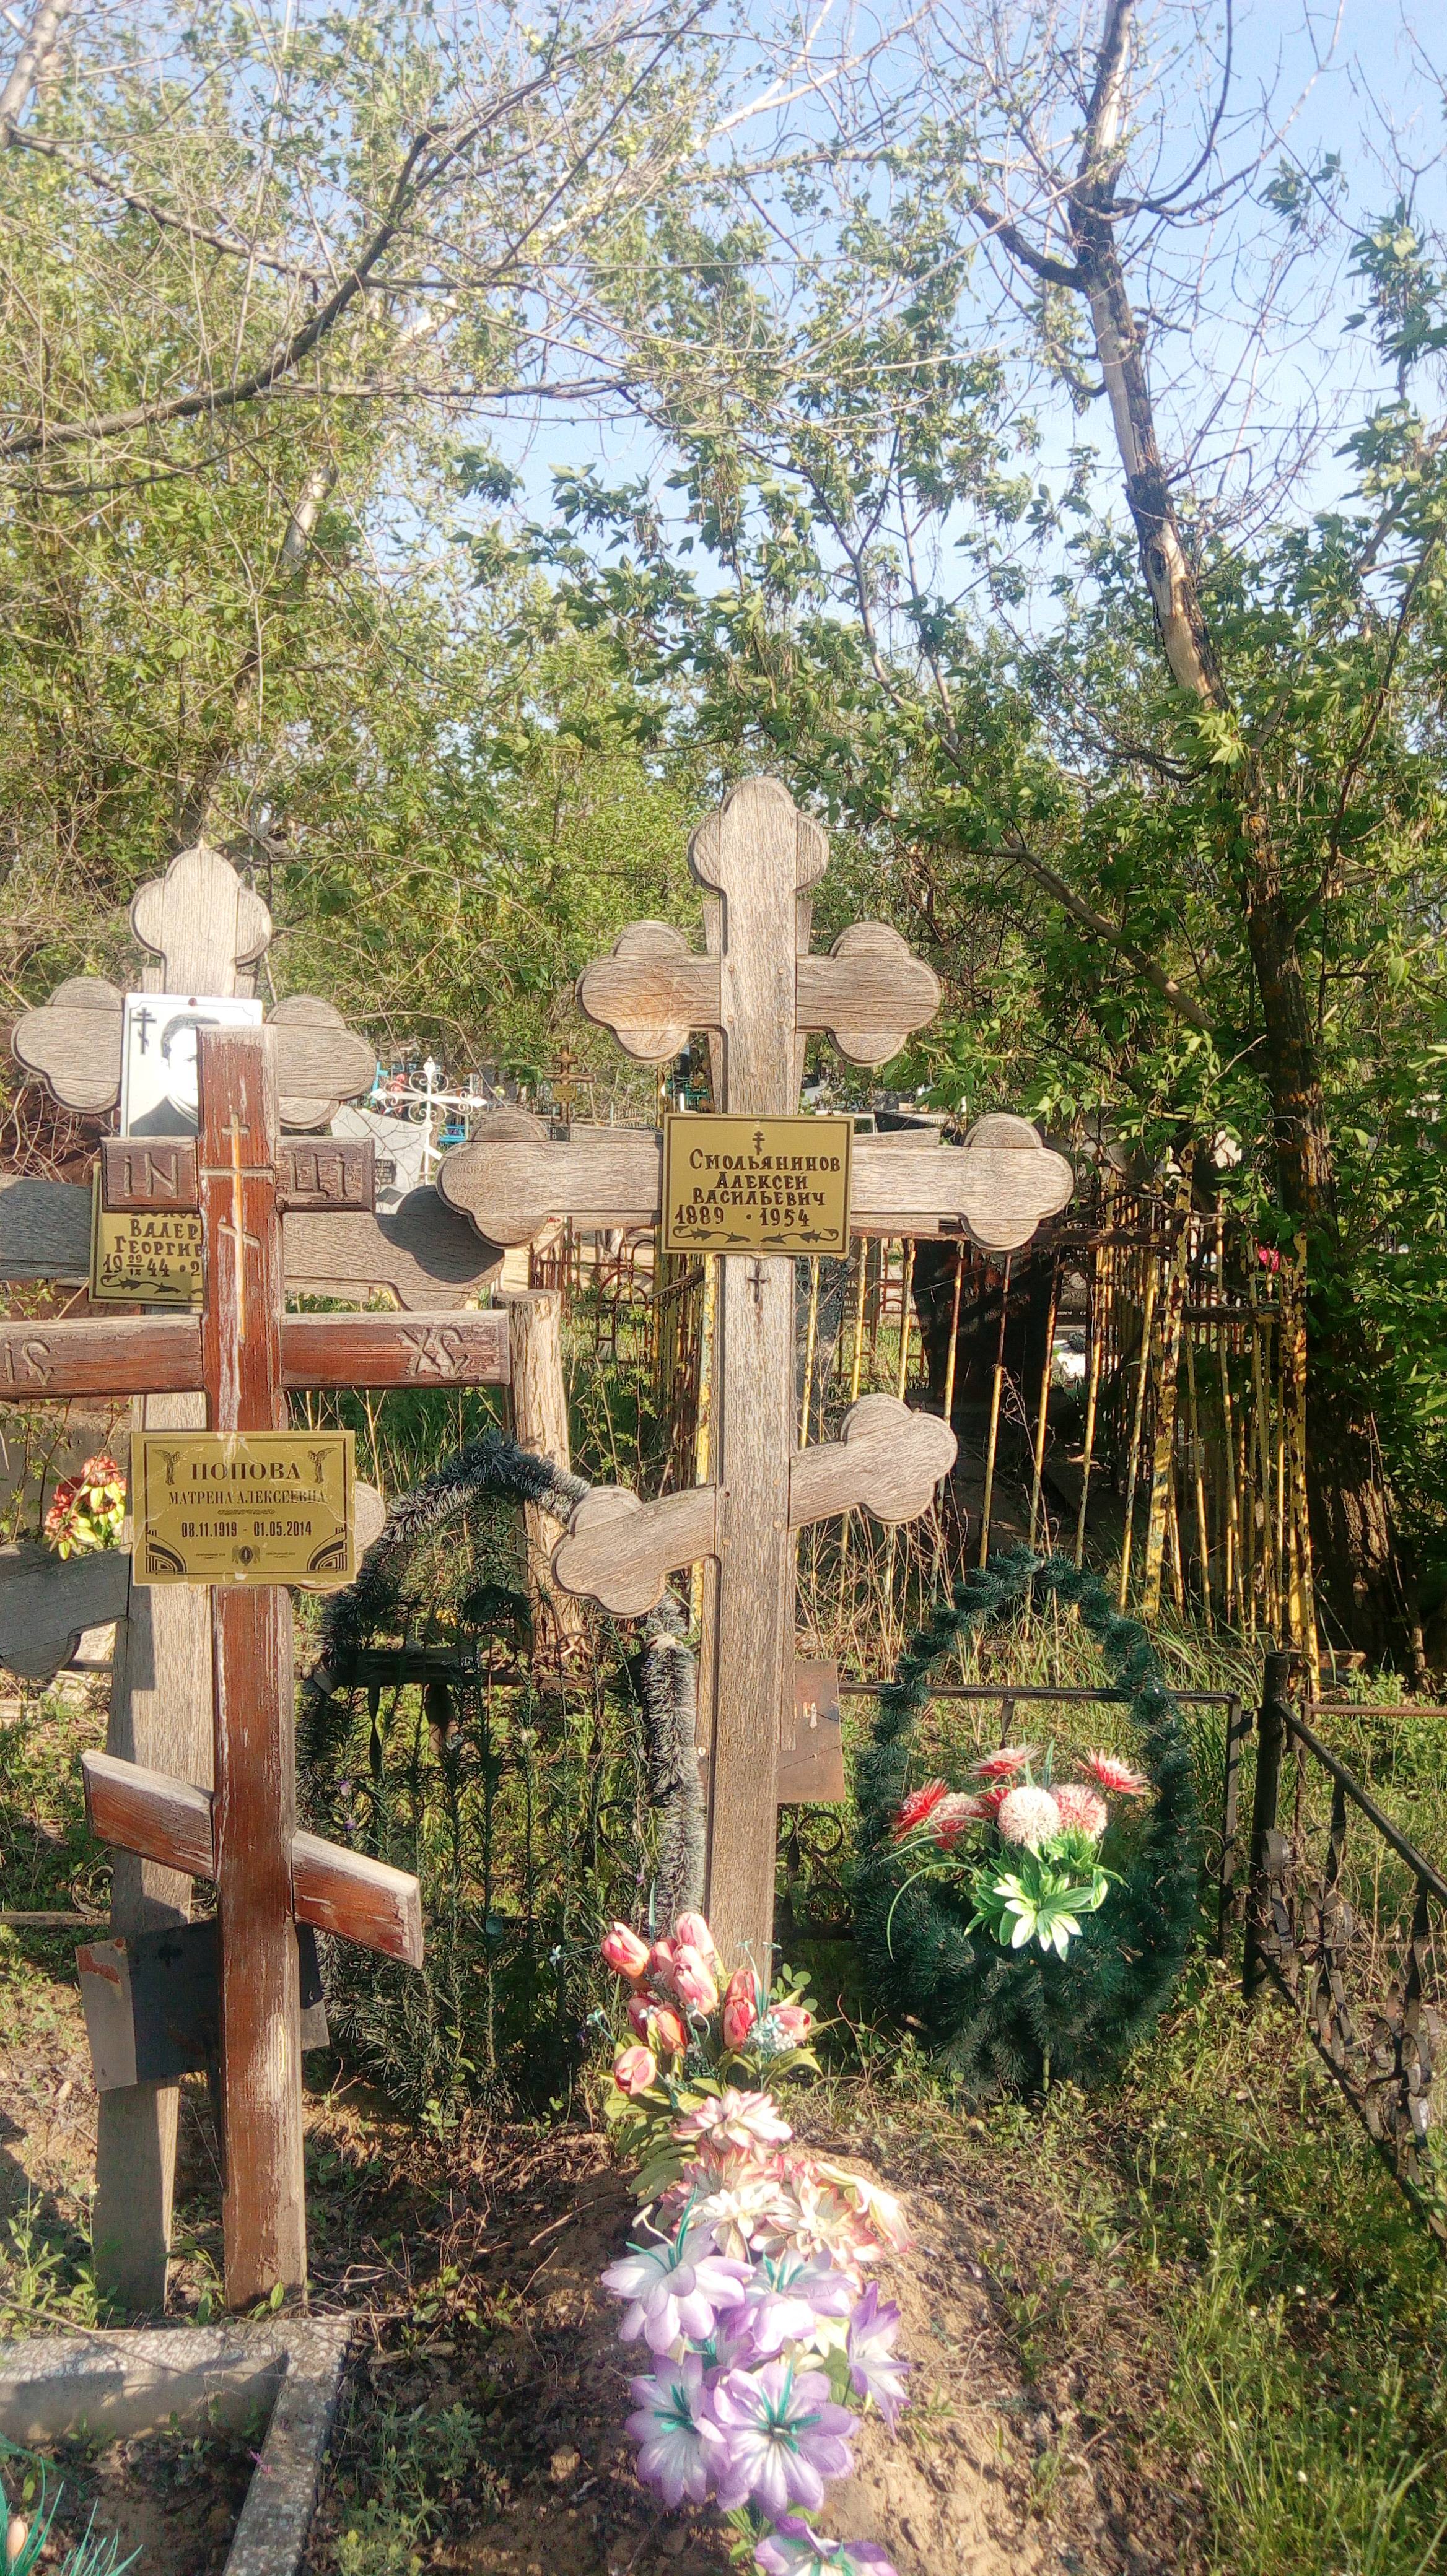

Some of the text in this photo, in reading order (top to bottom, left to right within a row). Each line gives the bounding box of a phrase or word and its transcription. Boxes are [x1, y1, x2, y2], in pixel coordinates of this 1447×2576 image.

[714, 1172, 808, 1190] АЛЕКСЕЙ
[693, 1188, 826, 1206] ВАСИЛЬЕВИЧ
[675, 1204, 724, 1225] 1889
[759, 1208, 810, 1227] 1954
[129, 1218, 202, 1240] ВАЛЕР
[191, 1462, 301, 1481] ПОПОВА
[168, 1489, 327, 1505] МАТРЕНА АЛЕКСЕЕВНА
[181, 1521, 237, 1538] 08.11.1919
[253, 1521, 312, 1537] 01.05.2014
